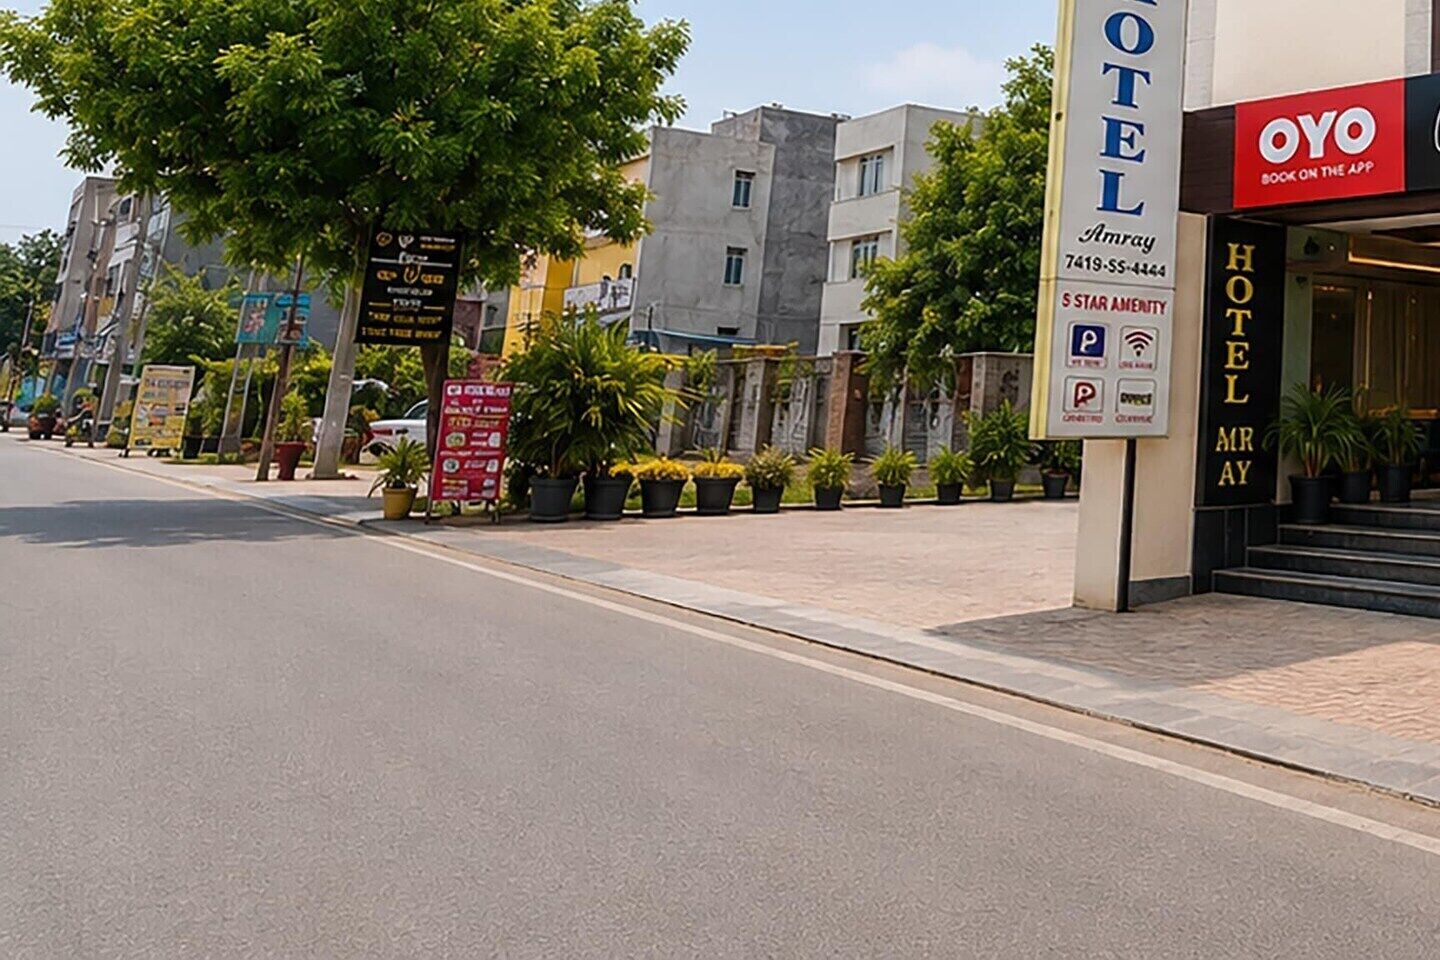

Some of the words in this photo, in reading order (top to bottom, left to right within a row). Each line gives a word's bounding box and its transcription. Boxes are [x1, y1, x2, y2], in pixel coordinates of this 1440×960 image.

[1259, 106, 1376, 164] OYO
[1261, 170, 1296, 185] BOOK
[1299, 167, 1318, 180] ON
[1321, 164, 1345, 177] THE
[1348, 160, 1374, 175] APP
[1078, 223, 1156, 254] Amray
[1074, 294, 1108, 311] STAR
[1224, 242, 1256, 405] HOTEL
